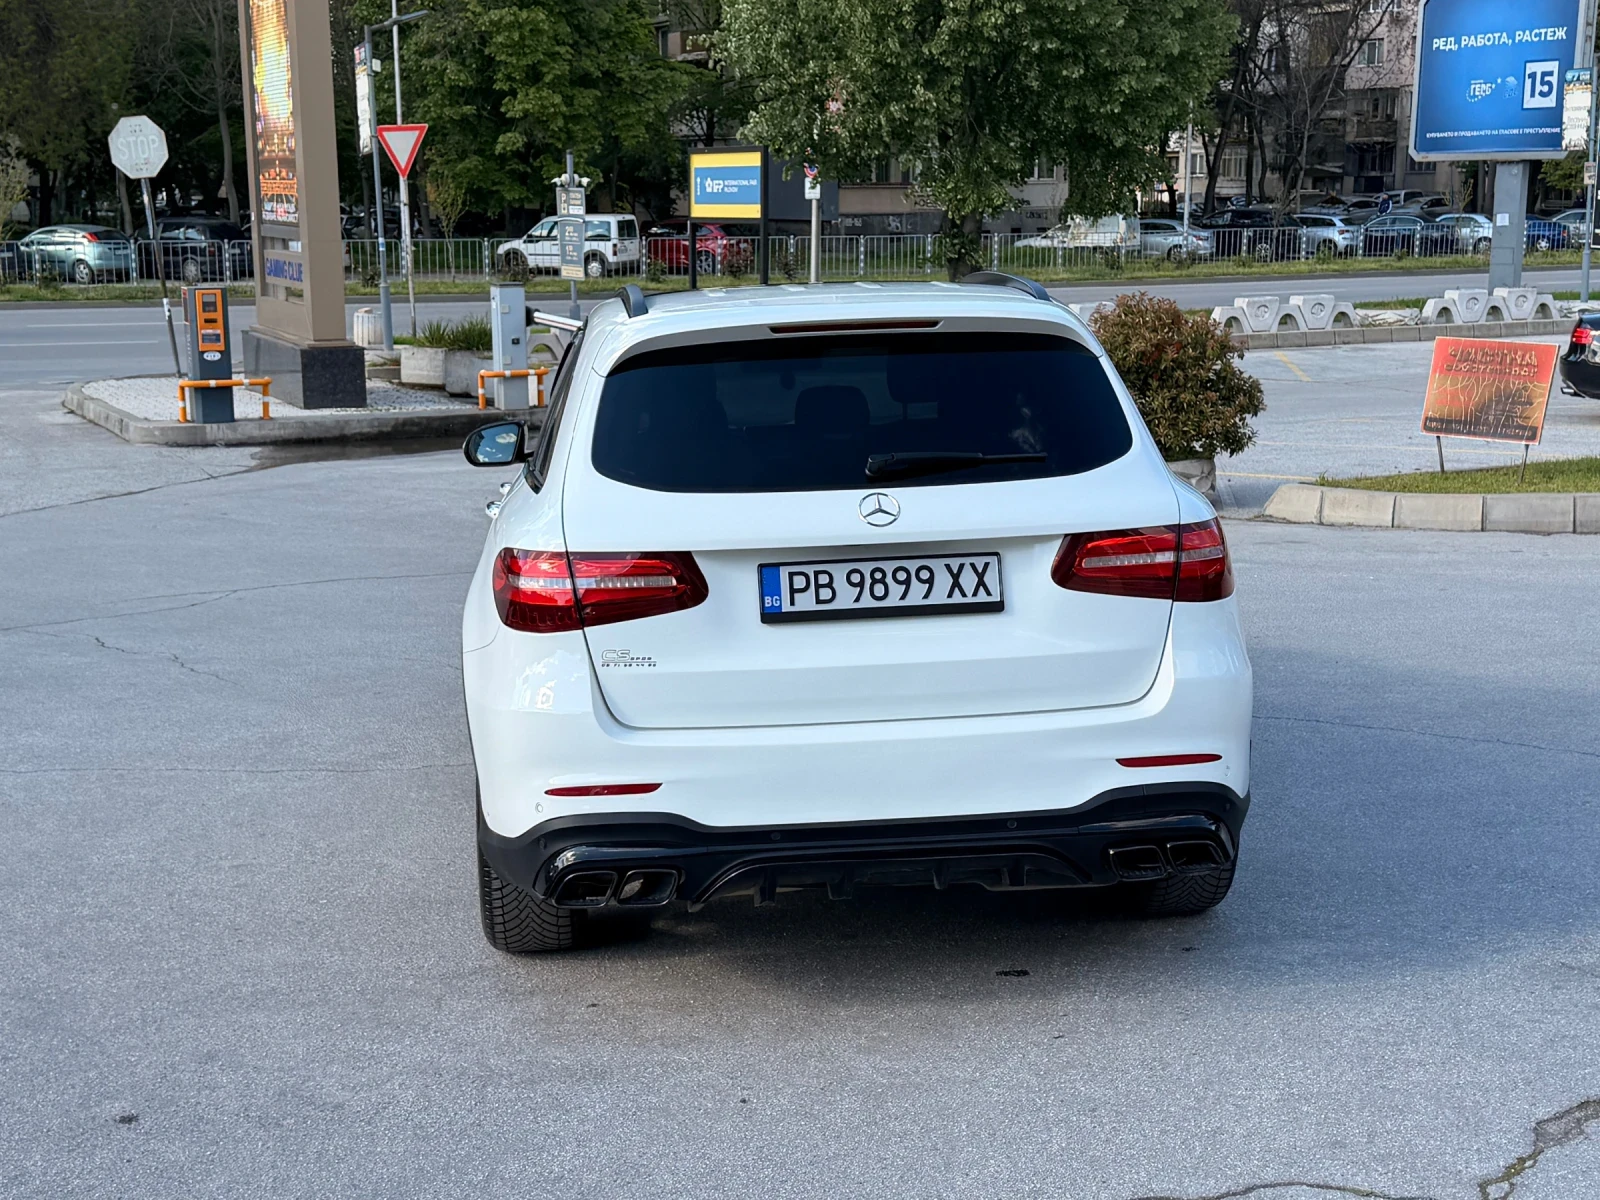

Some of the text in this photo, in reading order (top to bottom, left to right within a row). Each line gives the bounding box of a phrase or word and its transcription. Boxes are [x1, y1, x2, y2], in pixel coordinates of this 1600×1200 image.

[1432, 27, 1568, 51] РЕД, РАБОТА, РАСТЕЖ
[1527, 71, 1555, 99] 15
[117, 135, 159, 160] STOP
[787, 562, 993, 606] PB 9899 XX
[764, 596, 781, 607] BG
